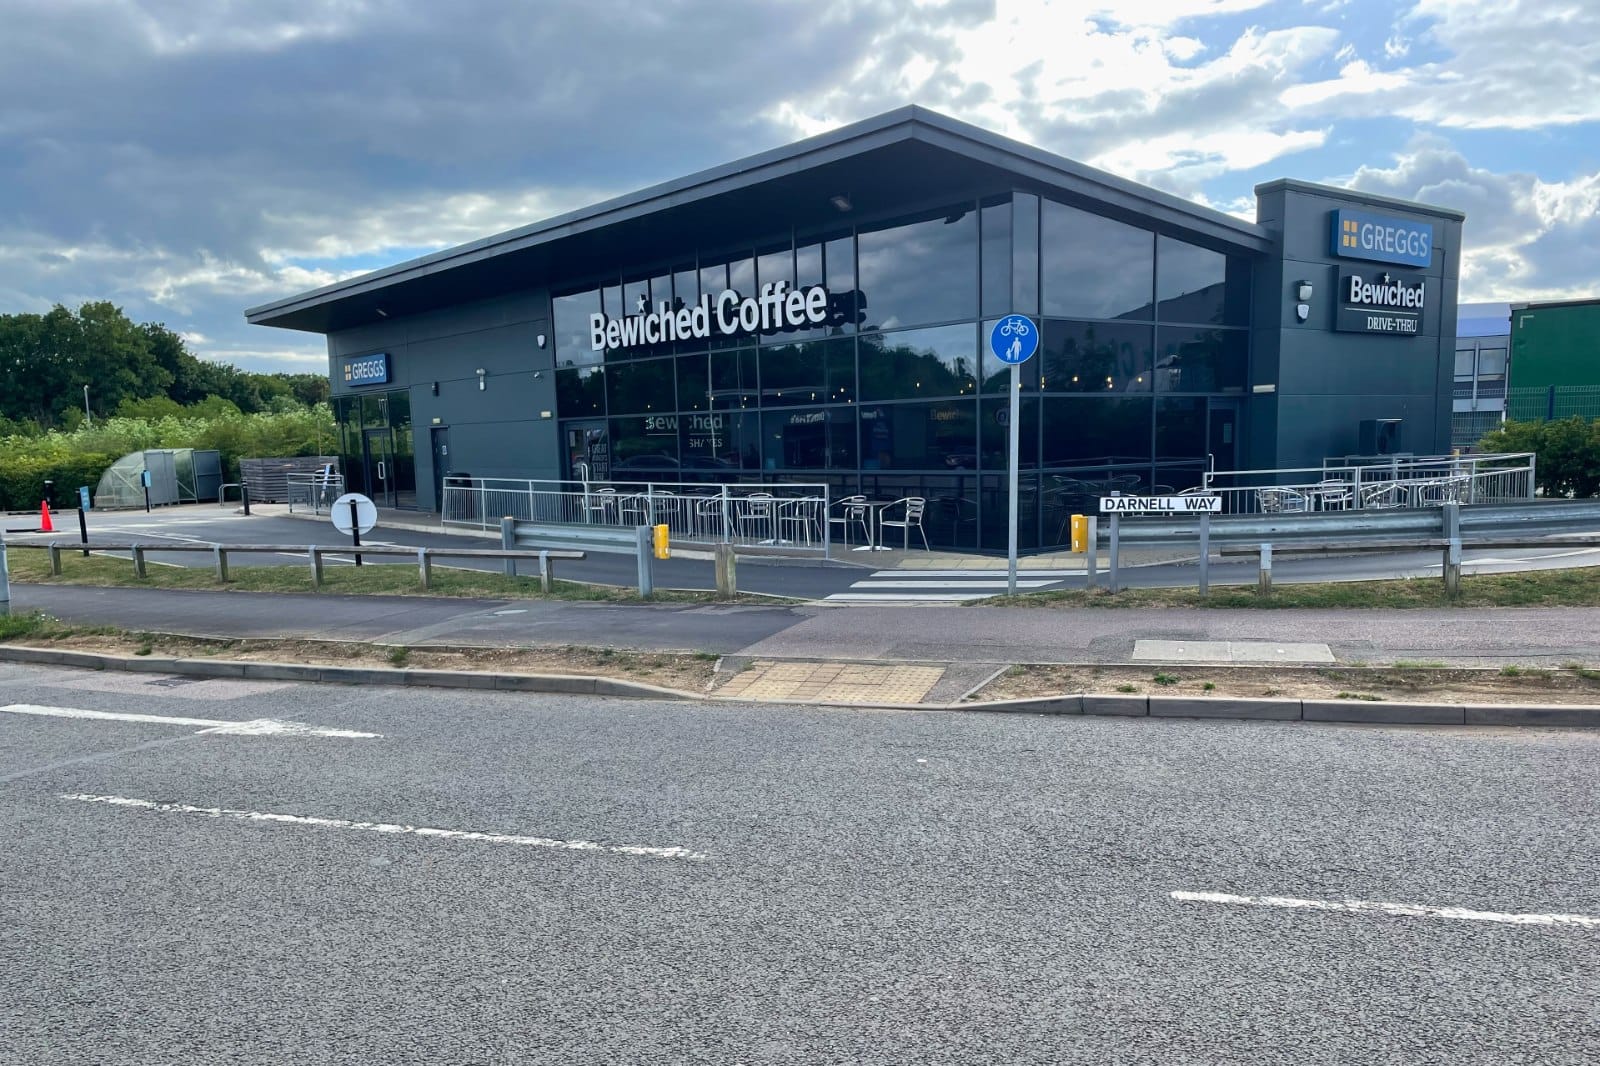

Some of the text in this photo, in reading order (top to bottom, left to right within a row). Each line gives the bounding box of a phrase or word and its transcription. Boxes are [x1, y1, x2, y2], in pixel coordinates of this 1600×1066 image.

[1361, 223, 1428, 257] GREGGS
[1351, 274, 1425, 308] Bewiched
[590, 280, 827, 350] Bewiched Coffee
[1367, 317, 1418, 332] DRIVE-THRU
[352, 359, 385, 379] GREGGS
[645, 413, 723, 430] ewhed
[1105, 498, 1216, 510] DARNELL WAY
